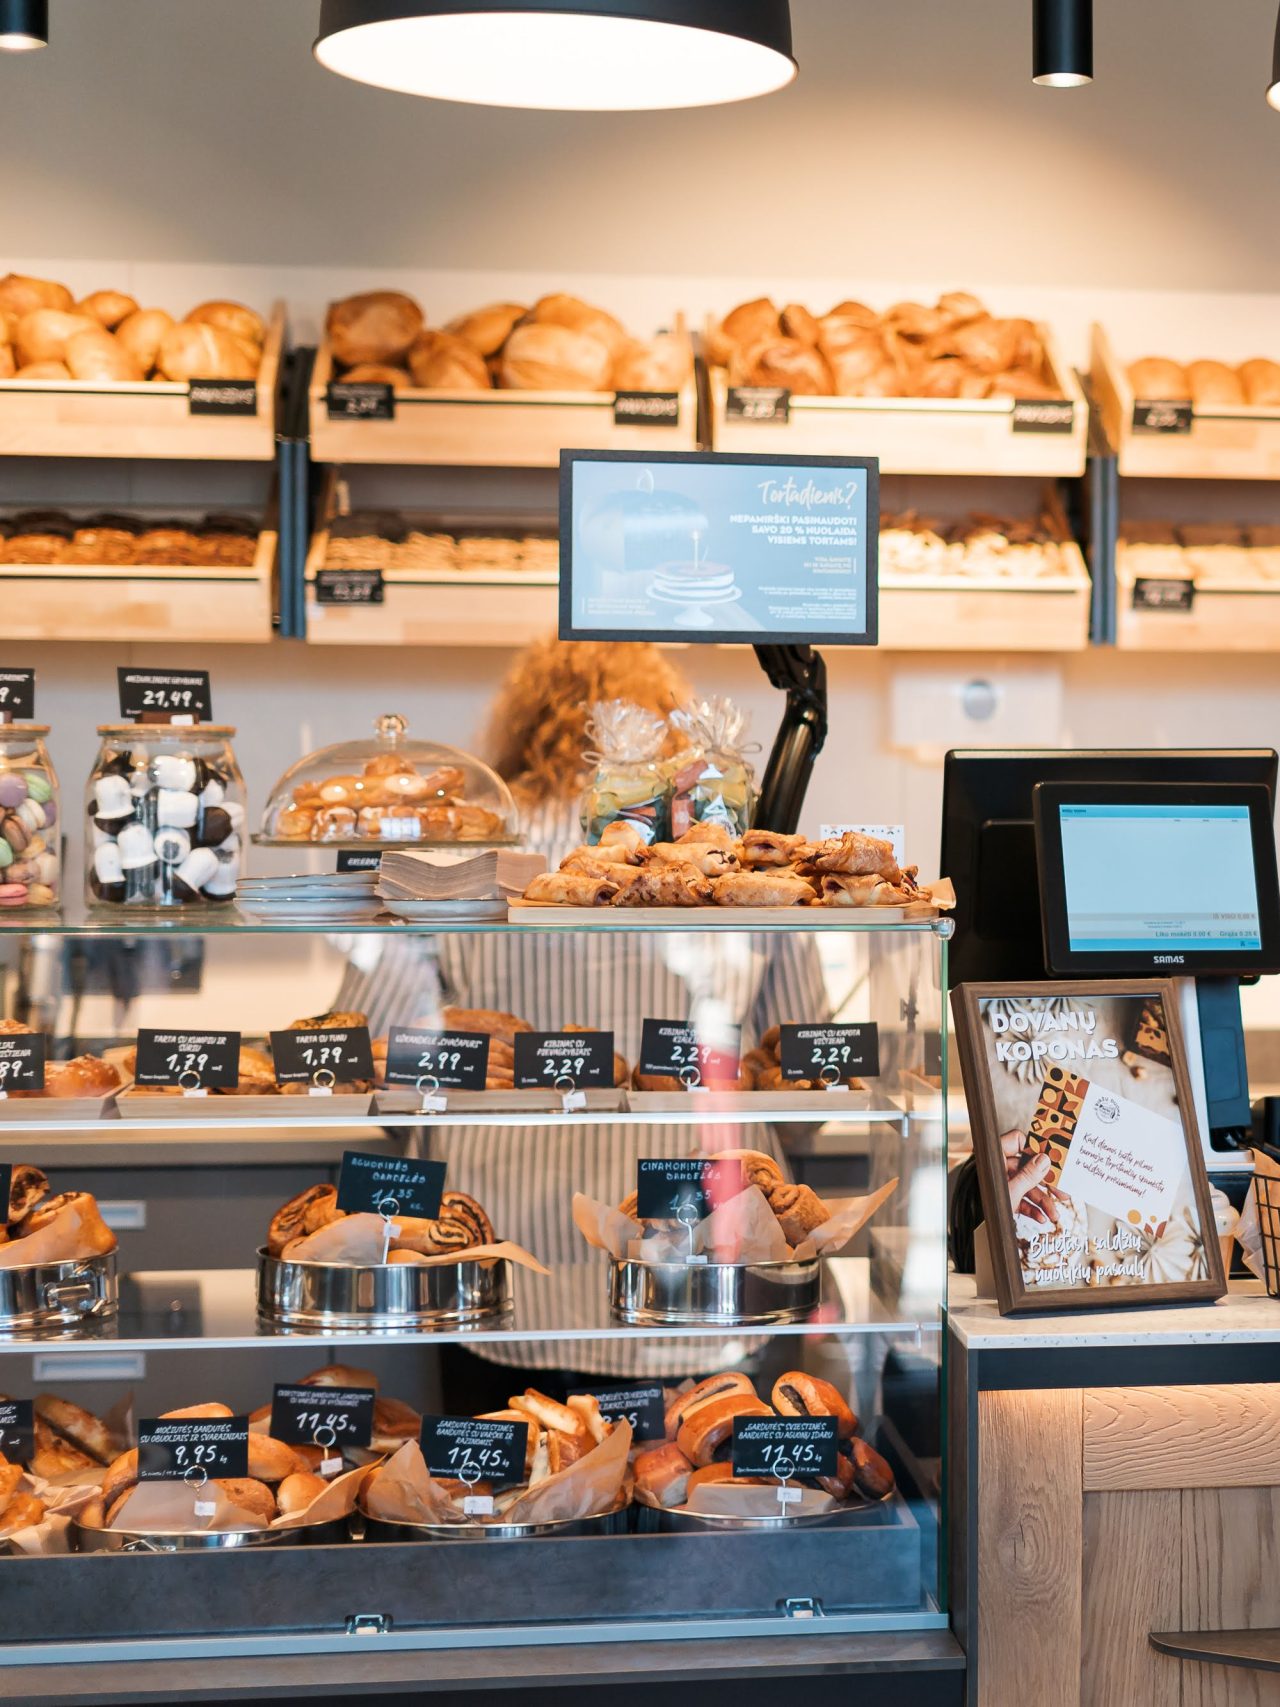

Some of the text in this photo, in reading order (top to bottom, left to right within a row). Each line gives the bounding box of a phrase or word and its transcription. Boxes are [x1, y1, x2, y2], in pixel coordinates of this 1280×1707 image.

[757, 476, 858, 510] Tortadienis?
[730, 514, 857, 526] NEPAMIRŠKI PASINAUDOTI
[752, 526, 778, 534] SAVO
[780, 526, 792, 534] 20
[794, 526, 804, 535] %
[768, 536, 807, 544] VISIEMS
[992, 1011, 1096, 1035] DOVANŲ
[166, 1054, 208, 1072] 1,79
[302, 1047, 342, 1066] 1,79
[418, 1052, 461, 1070] 2,99
[670, 1046, 711, 1064] 2,29
[811, 1046, 851, 1065] 2,29
[543, 1058, 584, 1076] 2,29
[1084, 1132, 1098, 1148] Kad
[1030, 1229, 1081, 1258] Bilietas
[1093, 1228, 1142, 1254] saldžių
[1035, 1255, 1145, 1286] nuotykių pasaulį
[176, 1445, 217, 1466] 9,95
[448, 1447, 502, 1467] 11,45
[761, 1444, 814, 1463] 11,45
